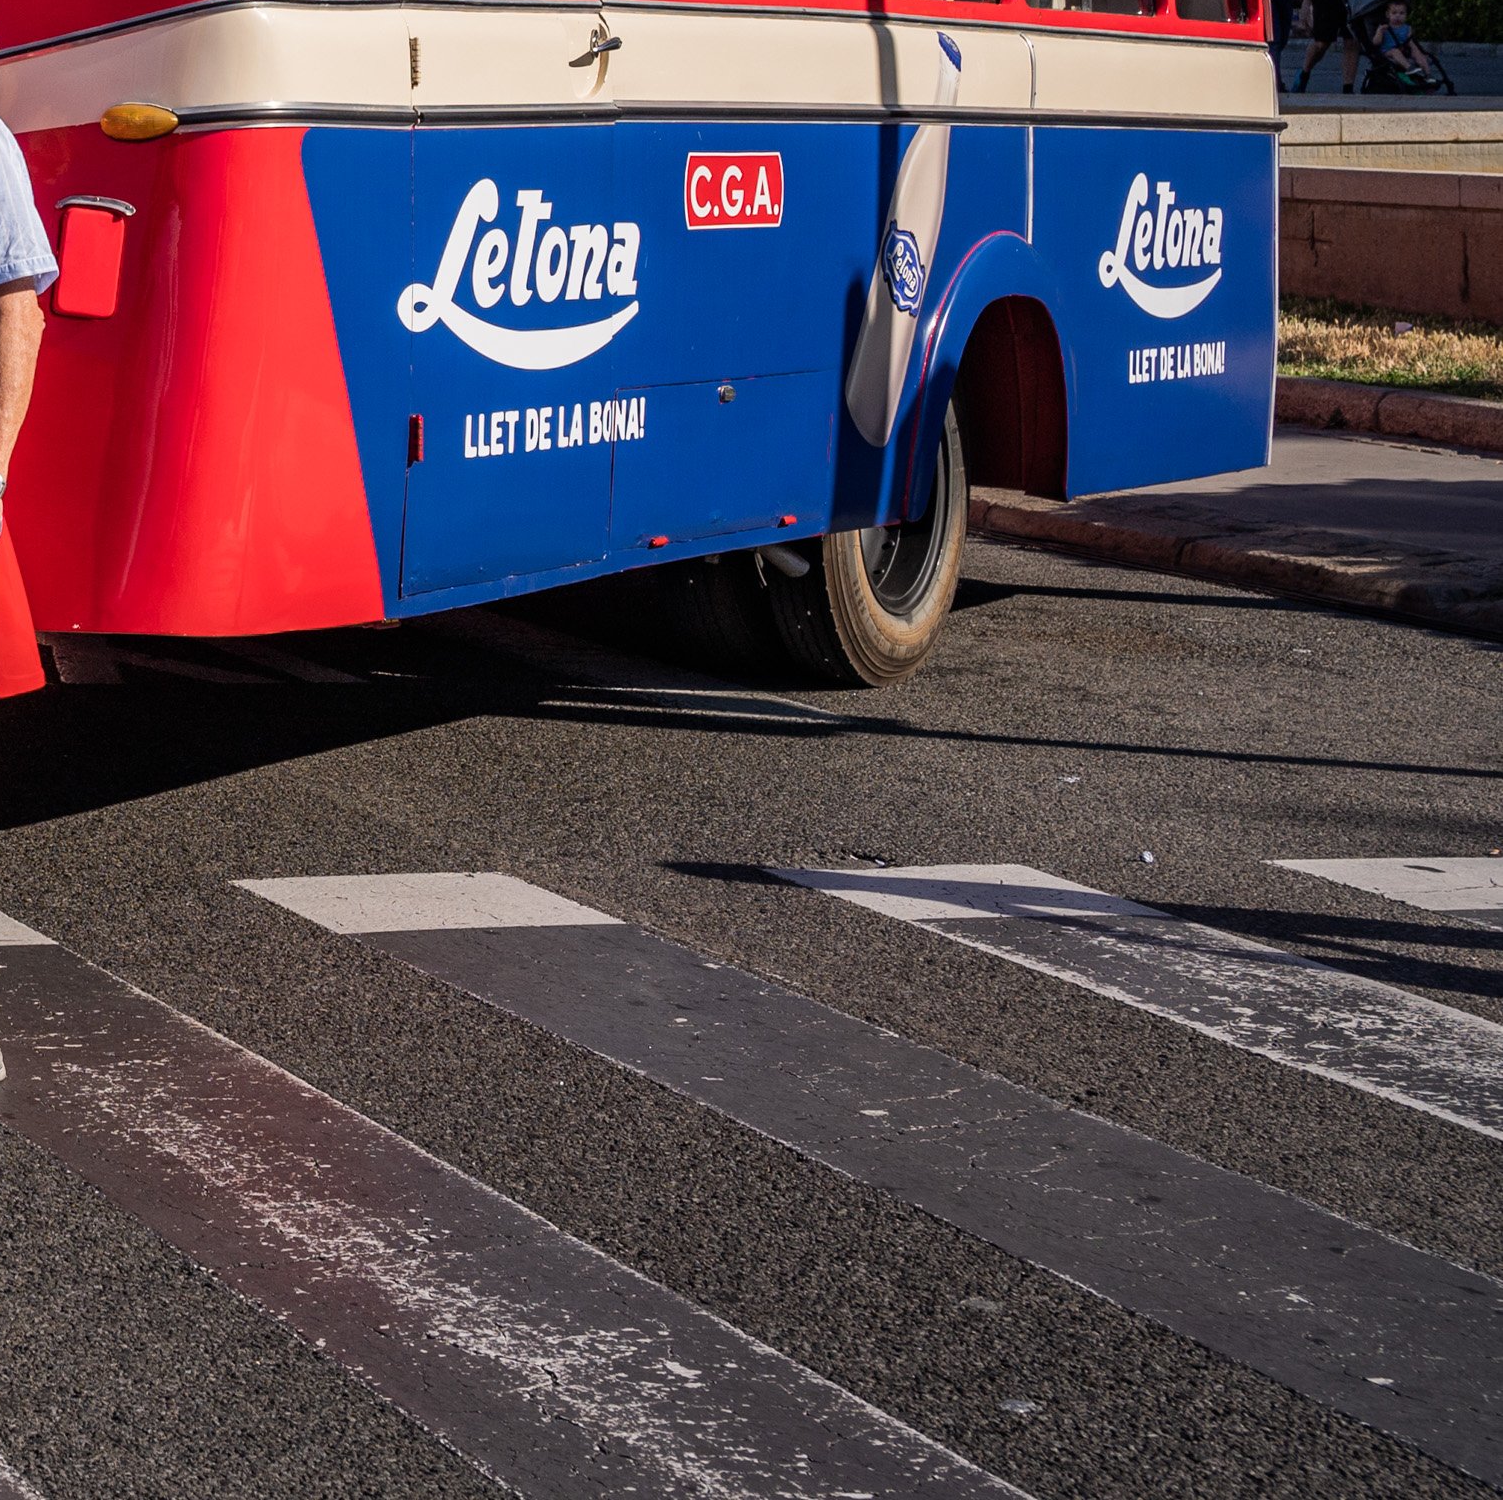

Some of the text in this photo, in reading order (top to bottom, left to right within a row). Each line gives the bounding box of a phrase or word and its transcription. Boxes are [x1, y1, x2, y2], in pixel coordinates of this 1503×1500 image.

[689, 162, 780, 220] C.G.A.
[397, 177, 642, 371] Letona
[887, 240, 919, 299] Letona
[1098, 172, 1224, 320] Letona
[1129, 341, 1226, 384] LLET DE LA BONA!
[464, 396, 646, 459] LLET DE LA BONA!
